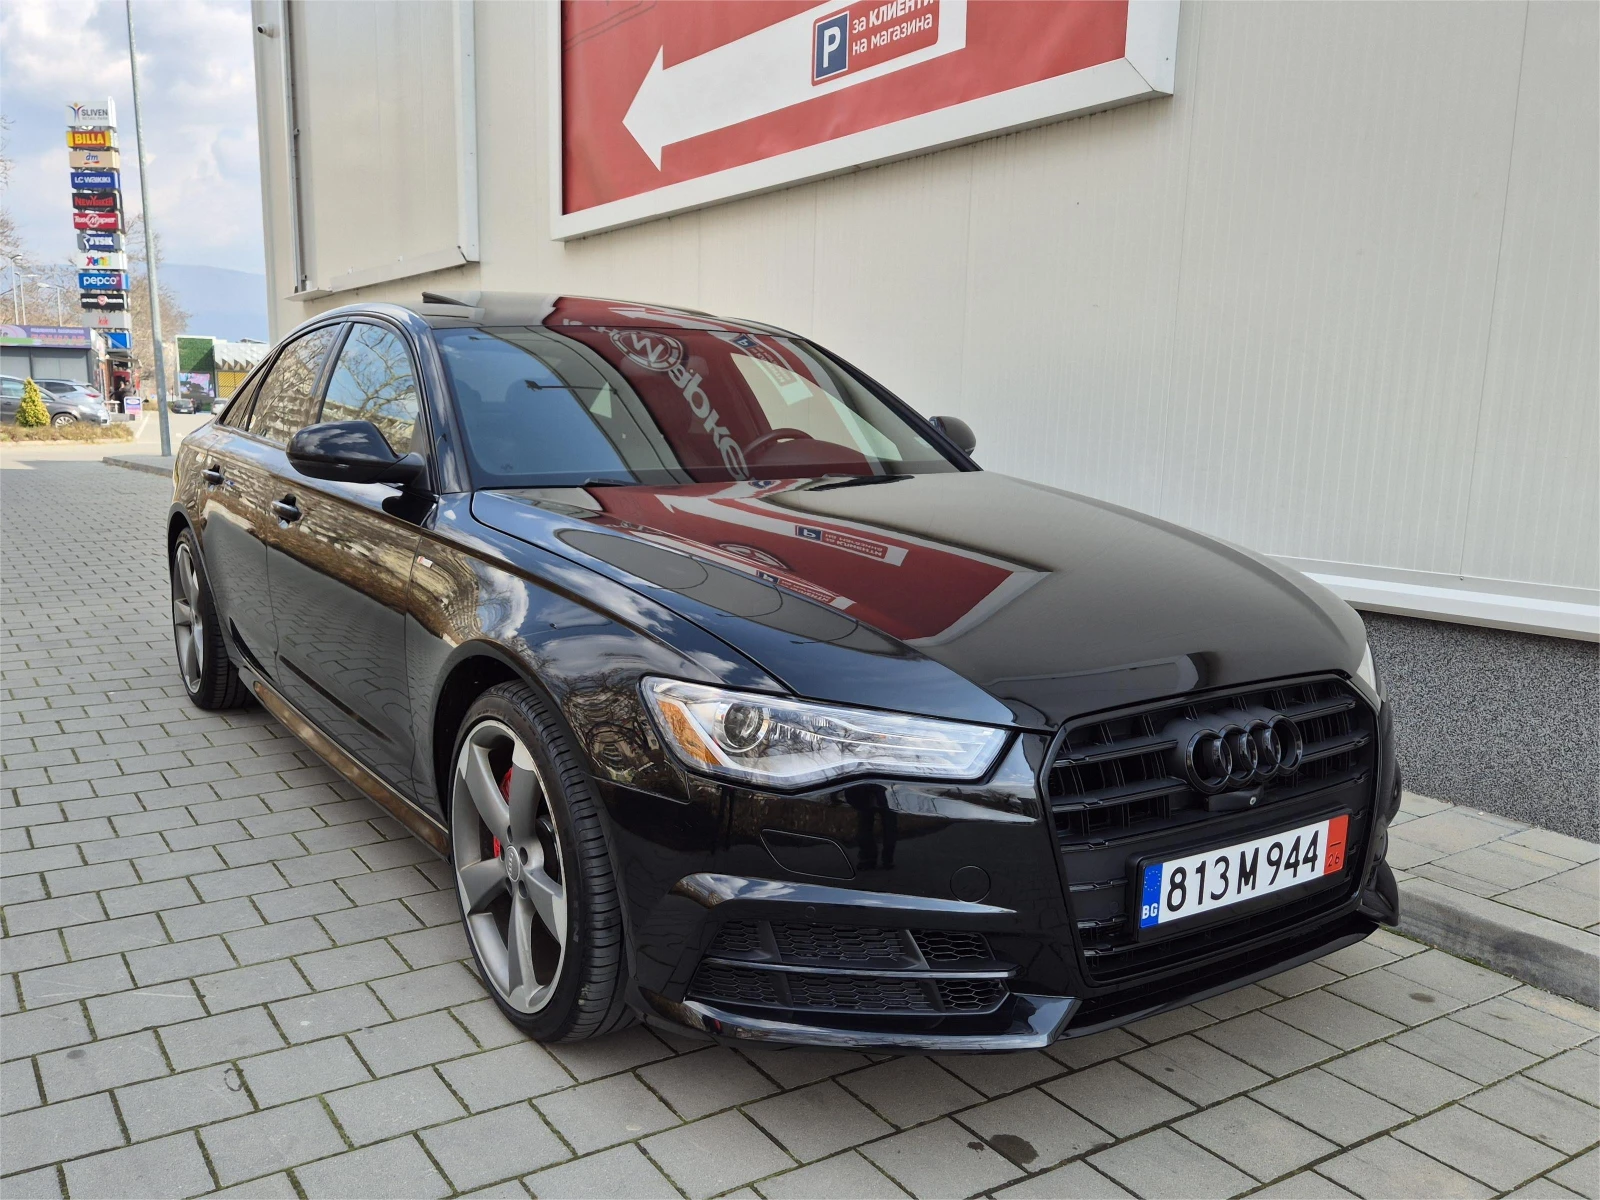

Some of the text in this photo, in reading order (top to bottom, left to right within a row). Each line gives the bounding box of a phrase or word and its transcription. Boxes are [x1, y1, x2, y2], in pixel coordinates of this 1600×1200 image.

[852, 16, 867, 34] за
[852, 13, 933, 55] на магазина
[823, 27, 841, 68] P
[74, 133, 104, 144] BILLA
[86, 153, 98, 161] dm
[89, 237, 114, 245] JYSK
[1328, 853, 1340, 867] 26
[1141, 903, 1158, 920] BG
